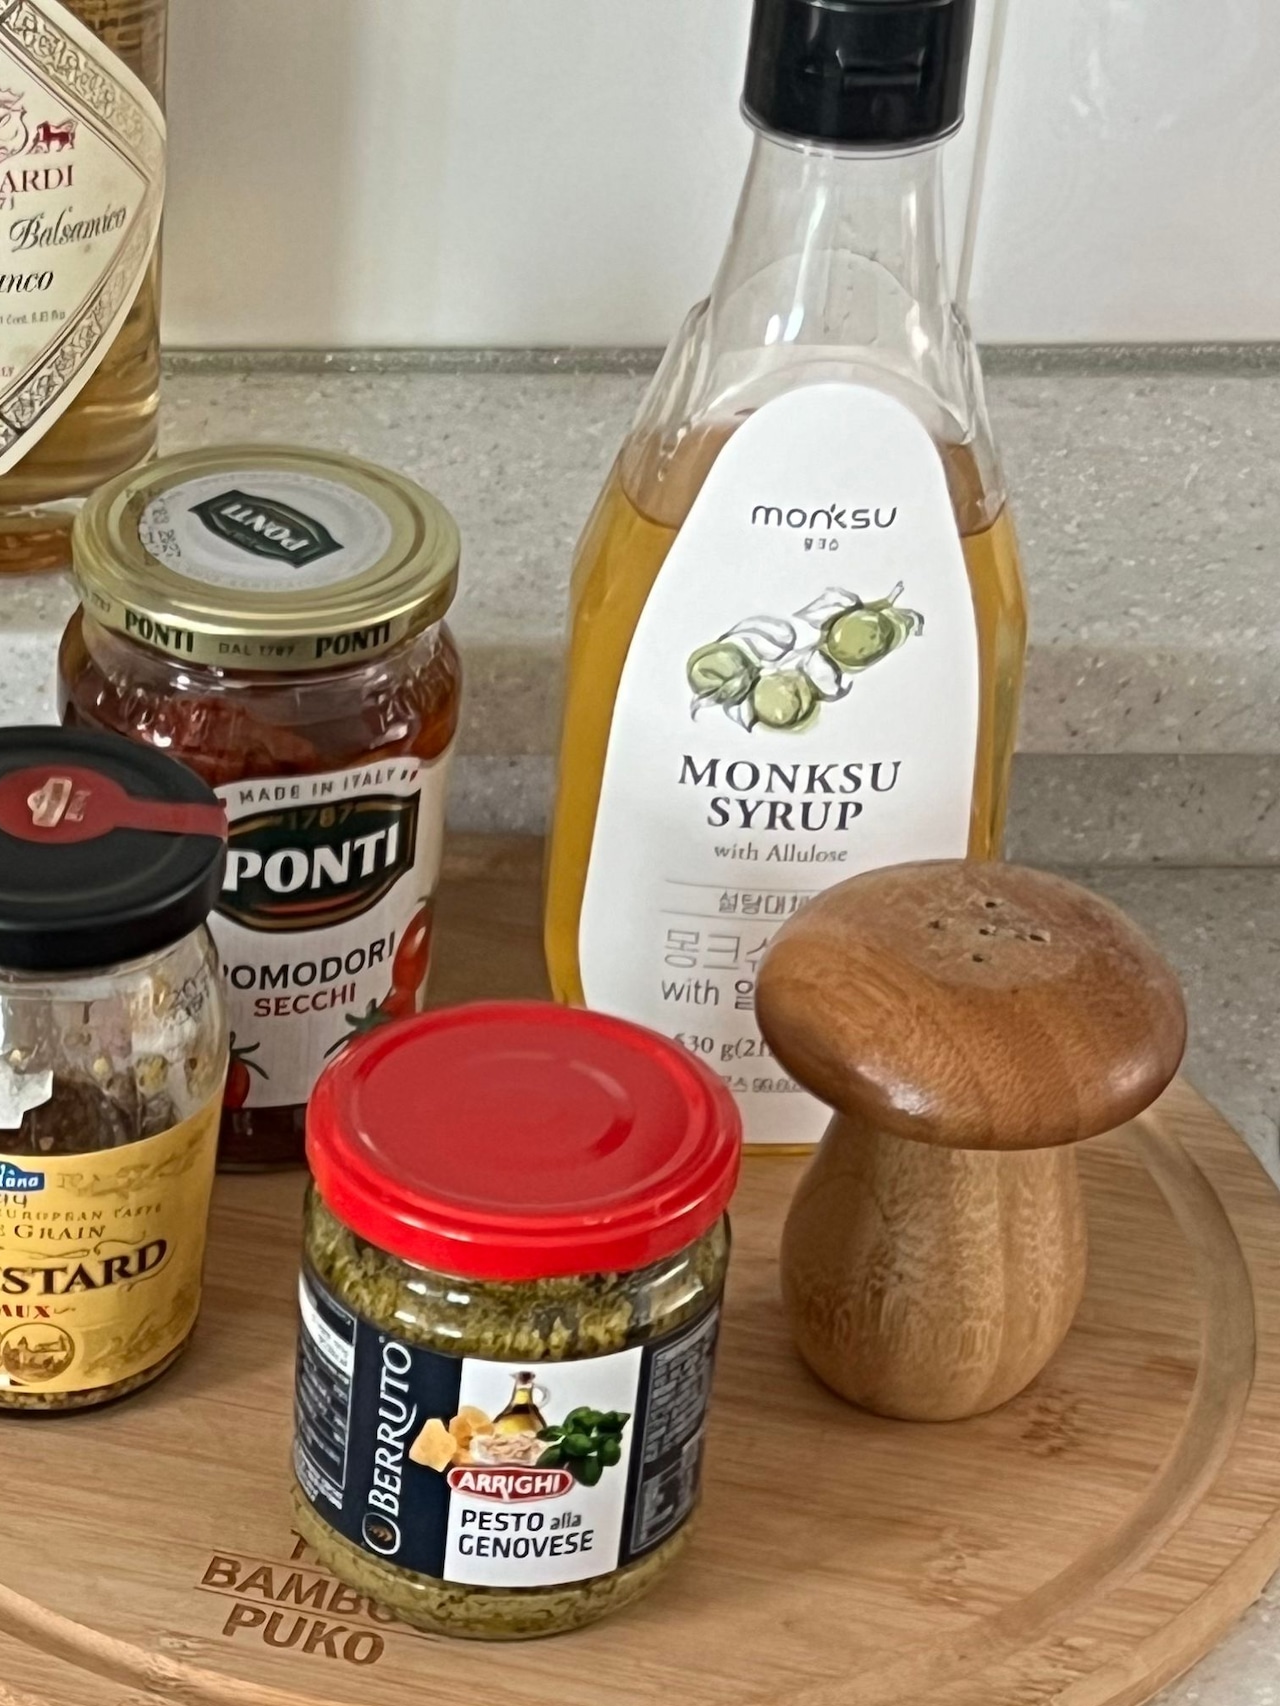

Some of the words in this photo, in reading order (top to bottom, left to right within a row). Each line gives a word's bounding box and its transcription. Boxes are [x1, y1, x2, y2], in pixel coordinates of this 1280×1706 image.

[9, 204, 127, 252] Balsamico
[220, 504, 310, 551] PONTI
[751, 503, 897, 530] monksu
[125, 608, 195, 653] PONTI
[219, 641, 251, 655] DAL
[315, 621, 390, 658] PONTI
[240, 785, 301, 805] MADE
[312, 781, 333, 796] IN
[343, 766, 396, 791] ITALY
[678, 755, 901, 794] MONKSU
[707, 796, 863, 831] SYRUP
[221, 821, 400, 894] PONTI
[714, 842, 759, 861] with
[765, 843, 848, 863] Allulose
[223, 930, 396, 990] OMODORI
[253, 982, 356, 1017] SECCHI
[662, 978, 720, 1006] with
[114, 1202, 162, 1219] TASTE
[14, 1224, 106, 1240] GRAIN
[368, 1341, 418, 1517] BERRUTO
[458, 1471, 560, 1500] ARRIGHI
[461, 1509, 544, 1532] PESTO
[550, 1511, 582, 1531] alla
[458, 1530, 595, 1559] GENOVESE
[222, 1602, 385, 1666] PUKO
